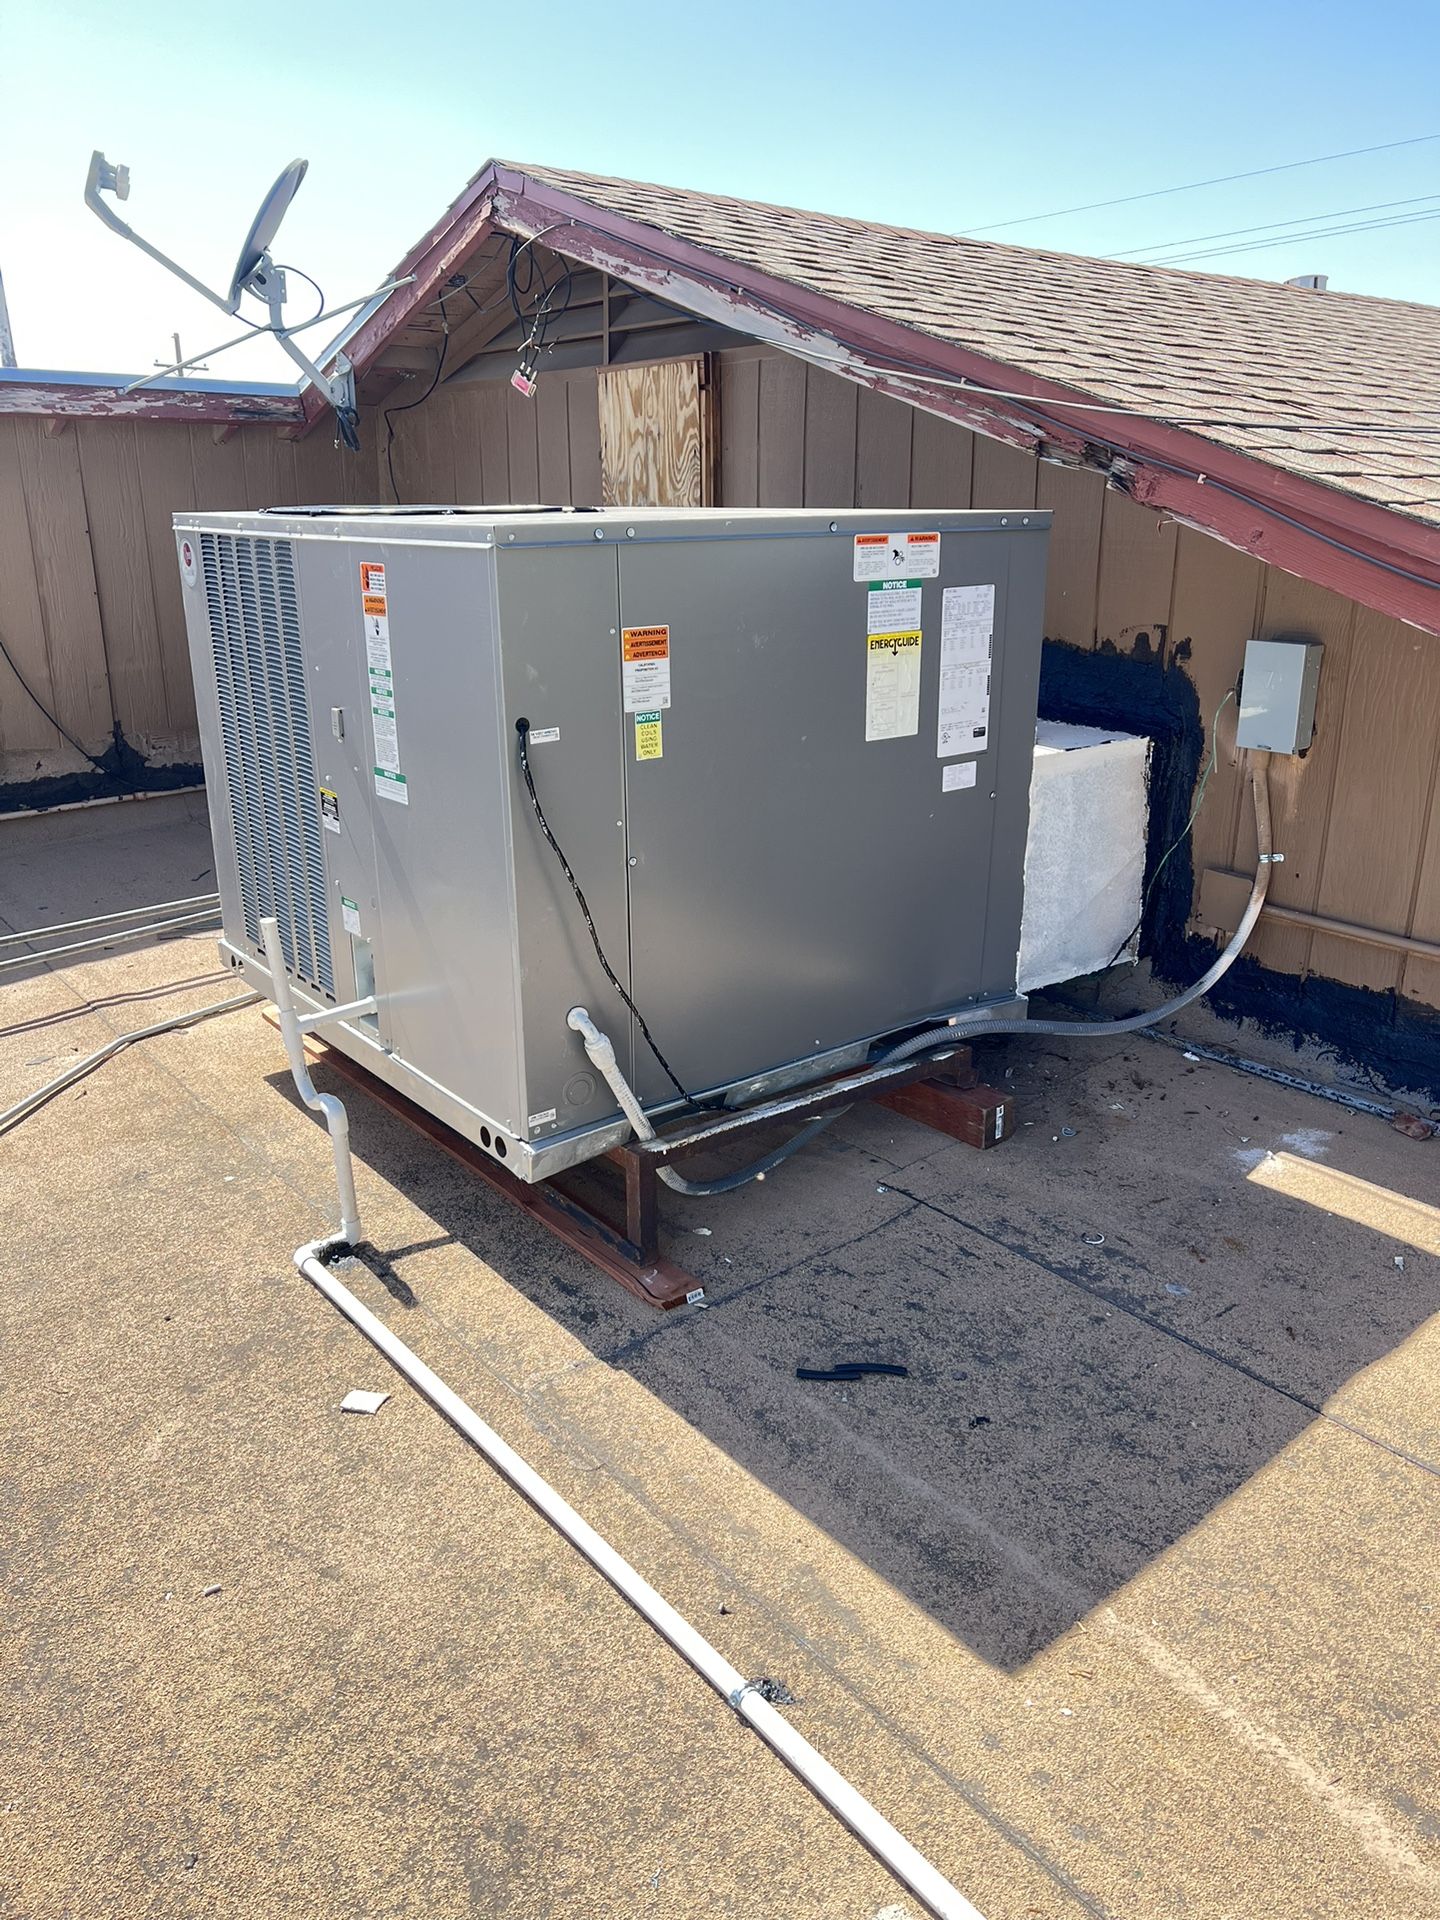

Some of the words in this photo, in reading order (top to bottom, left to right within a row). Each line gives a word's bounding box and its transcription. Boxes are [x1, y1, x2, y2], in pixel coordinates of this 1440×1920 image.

[882, 580, 907, 590] NOTICE
[630, 628, 667, 638] WARNING
[631, 639, 667, 648] AVERTISSEMENT
[870, 636, 920, 650] ENERGYGUIDE
[633, 650, 666, 658] ADVERTENCIA
[636, 712, 660, 722] NOTICE
